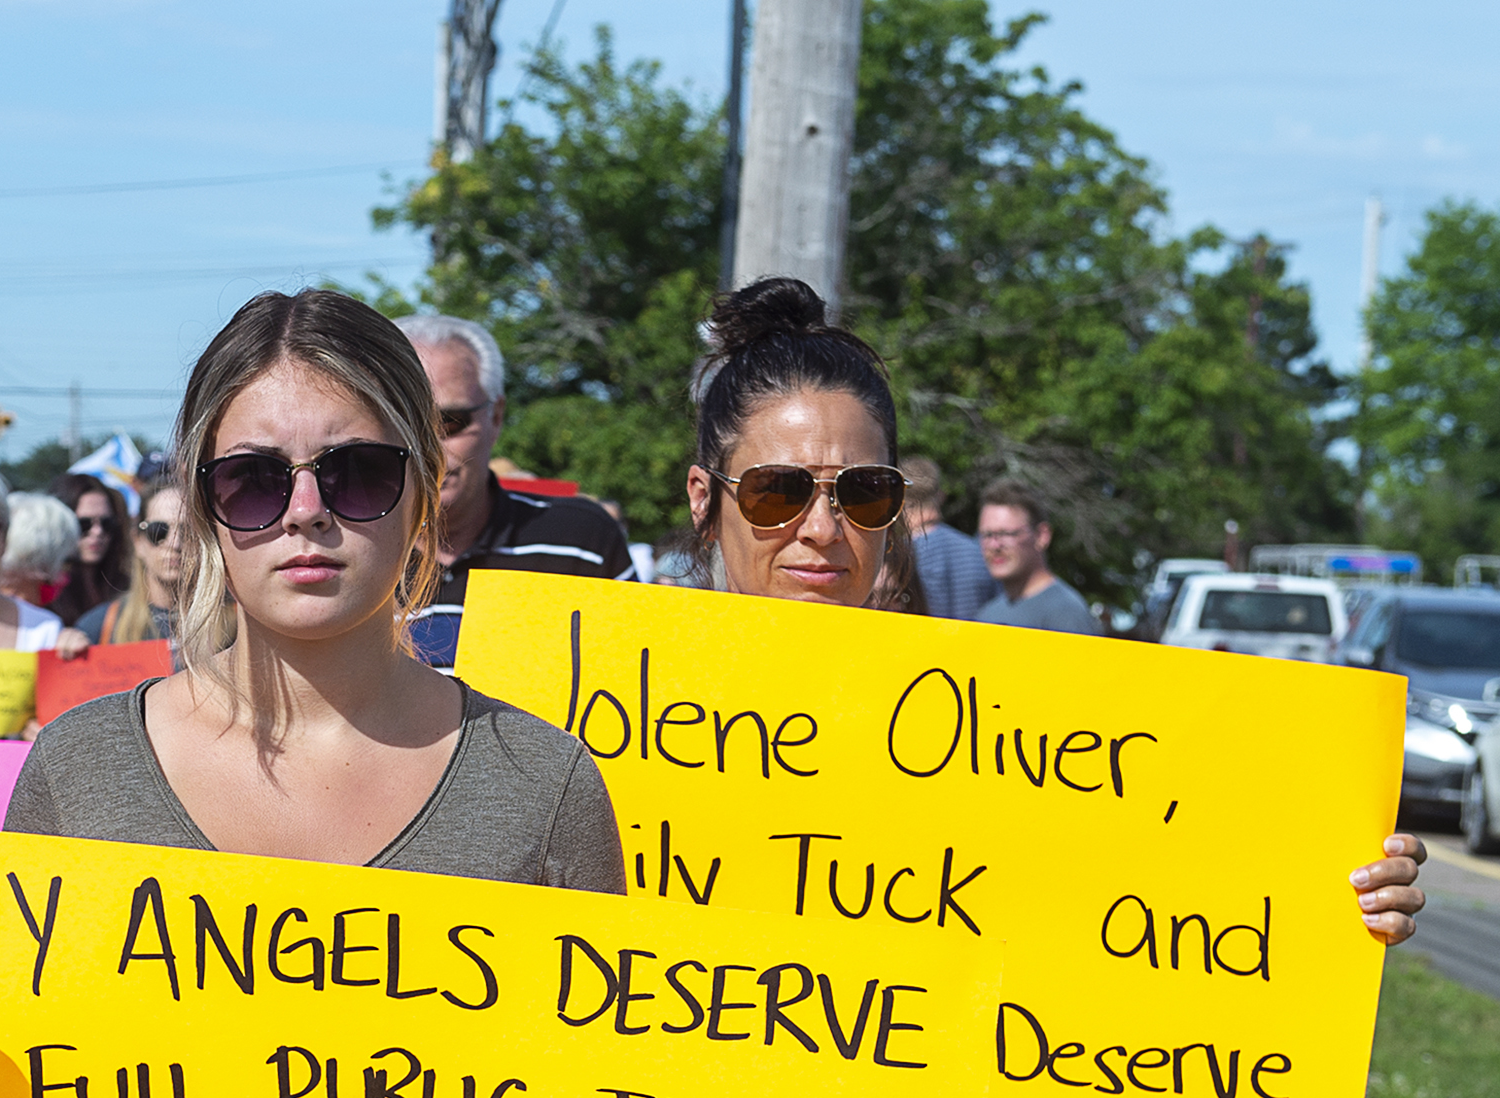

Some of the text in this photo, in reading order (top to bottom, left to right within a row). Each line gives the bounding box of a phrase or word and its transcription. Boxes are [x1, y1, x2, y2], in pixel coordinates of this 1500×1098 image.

[565, 609, 1179, 824] Jolene Oliver,
[116, 876, 499, 1011] ANGELS
[553, 934, 928, 1070] DESERVE
[1101, 893, 1271, 982] and
